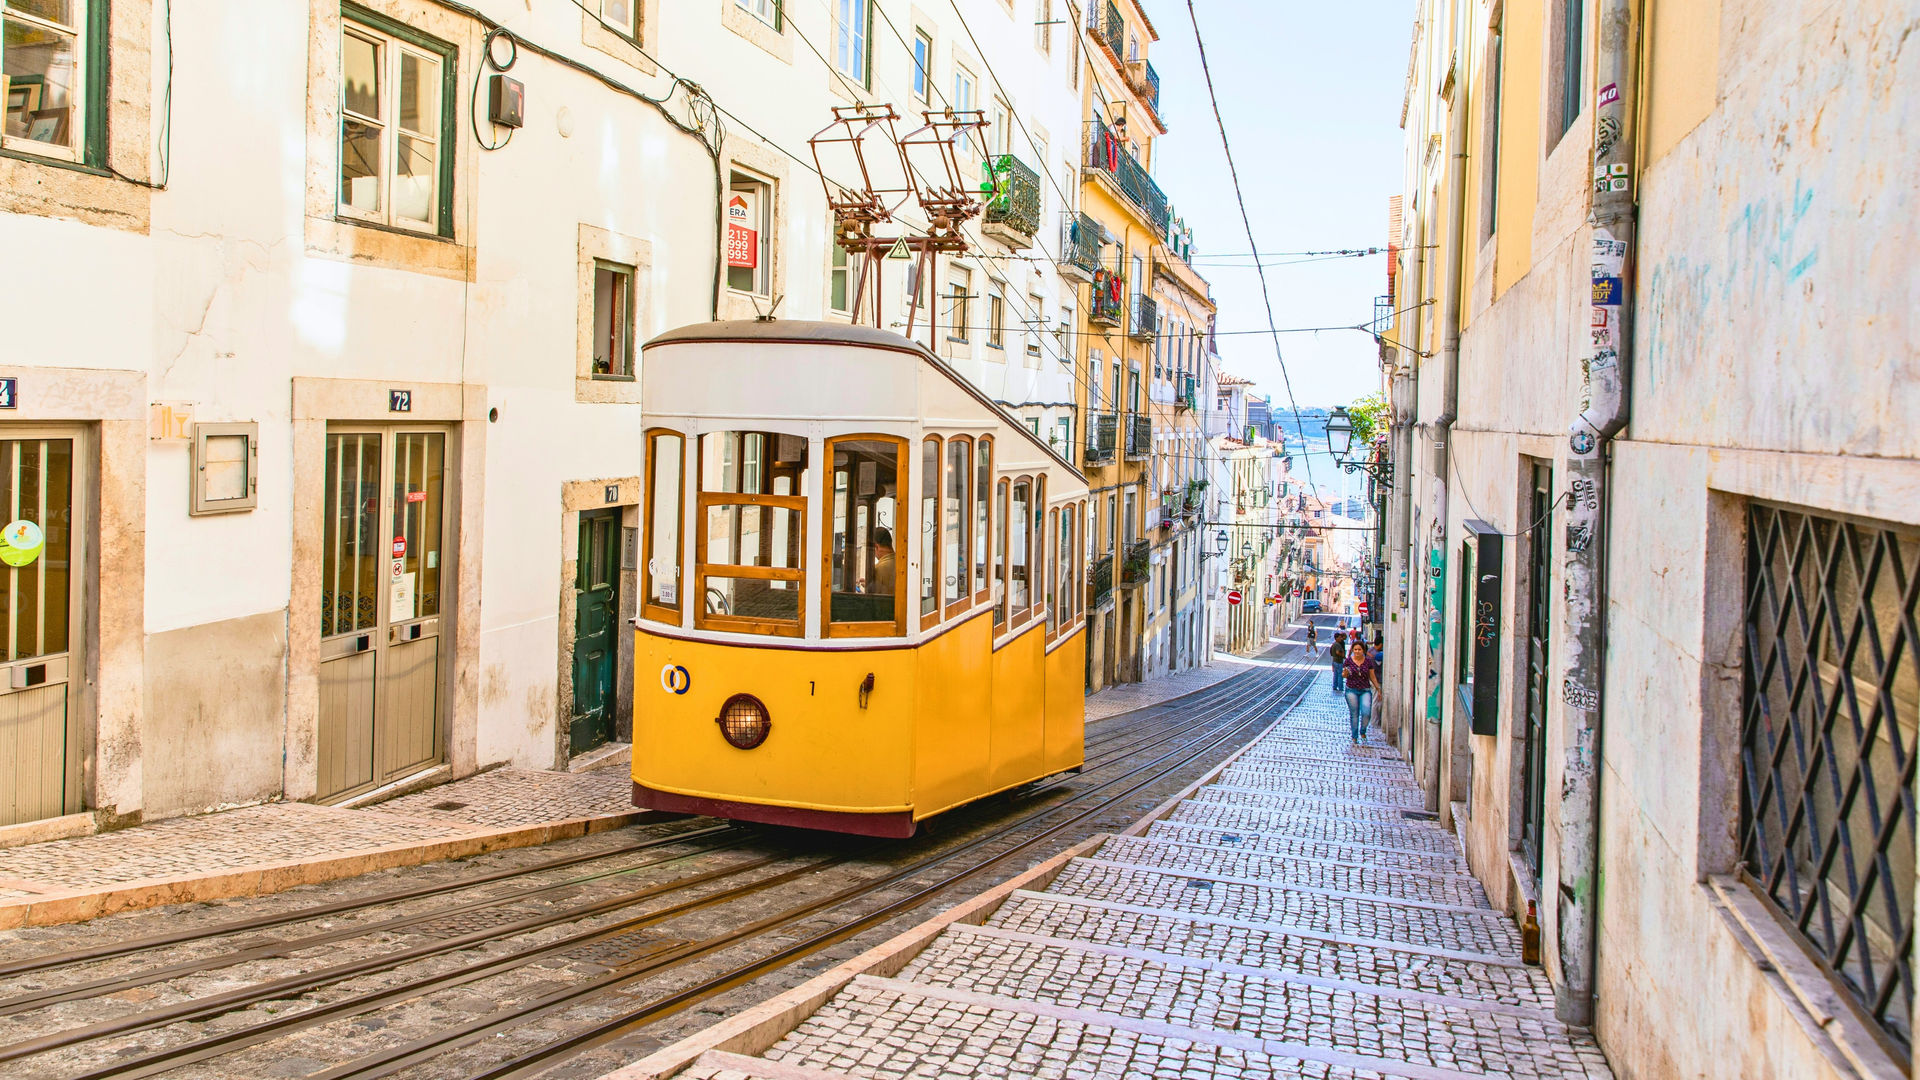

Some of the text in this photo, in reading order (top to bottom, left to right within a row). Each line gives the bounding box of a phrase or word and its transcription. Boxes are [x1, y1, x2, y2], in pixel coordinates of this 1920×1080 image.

[730, 207, 747, 217] ERA
[729, 229, 749, 241] 215
[729, 239, 749, 251] 999
[728, 249, 749, 261] 995
[394, 391, 408, 411] 72
[608, 486, 618, 502] 70
[810, 681, 815, 696] 1
